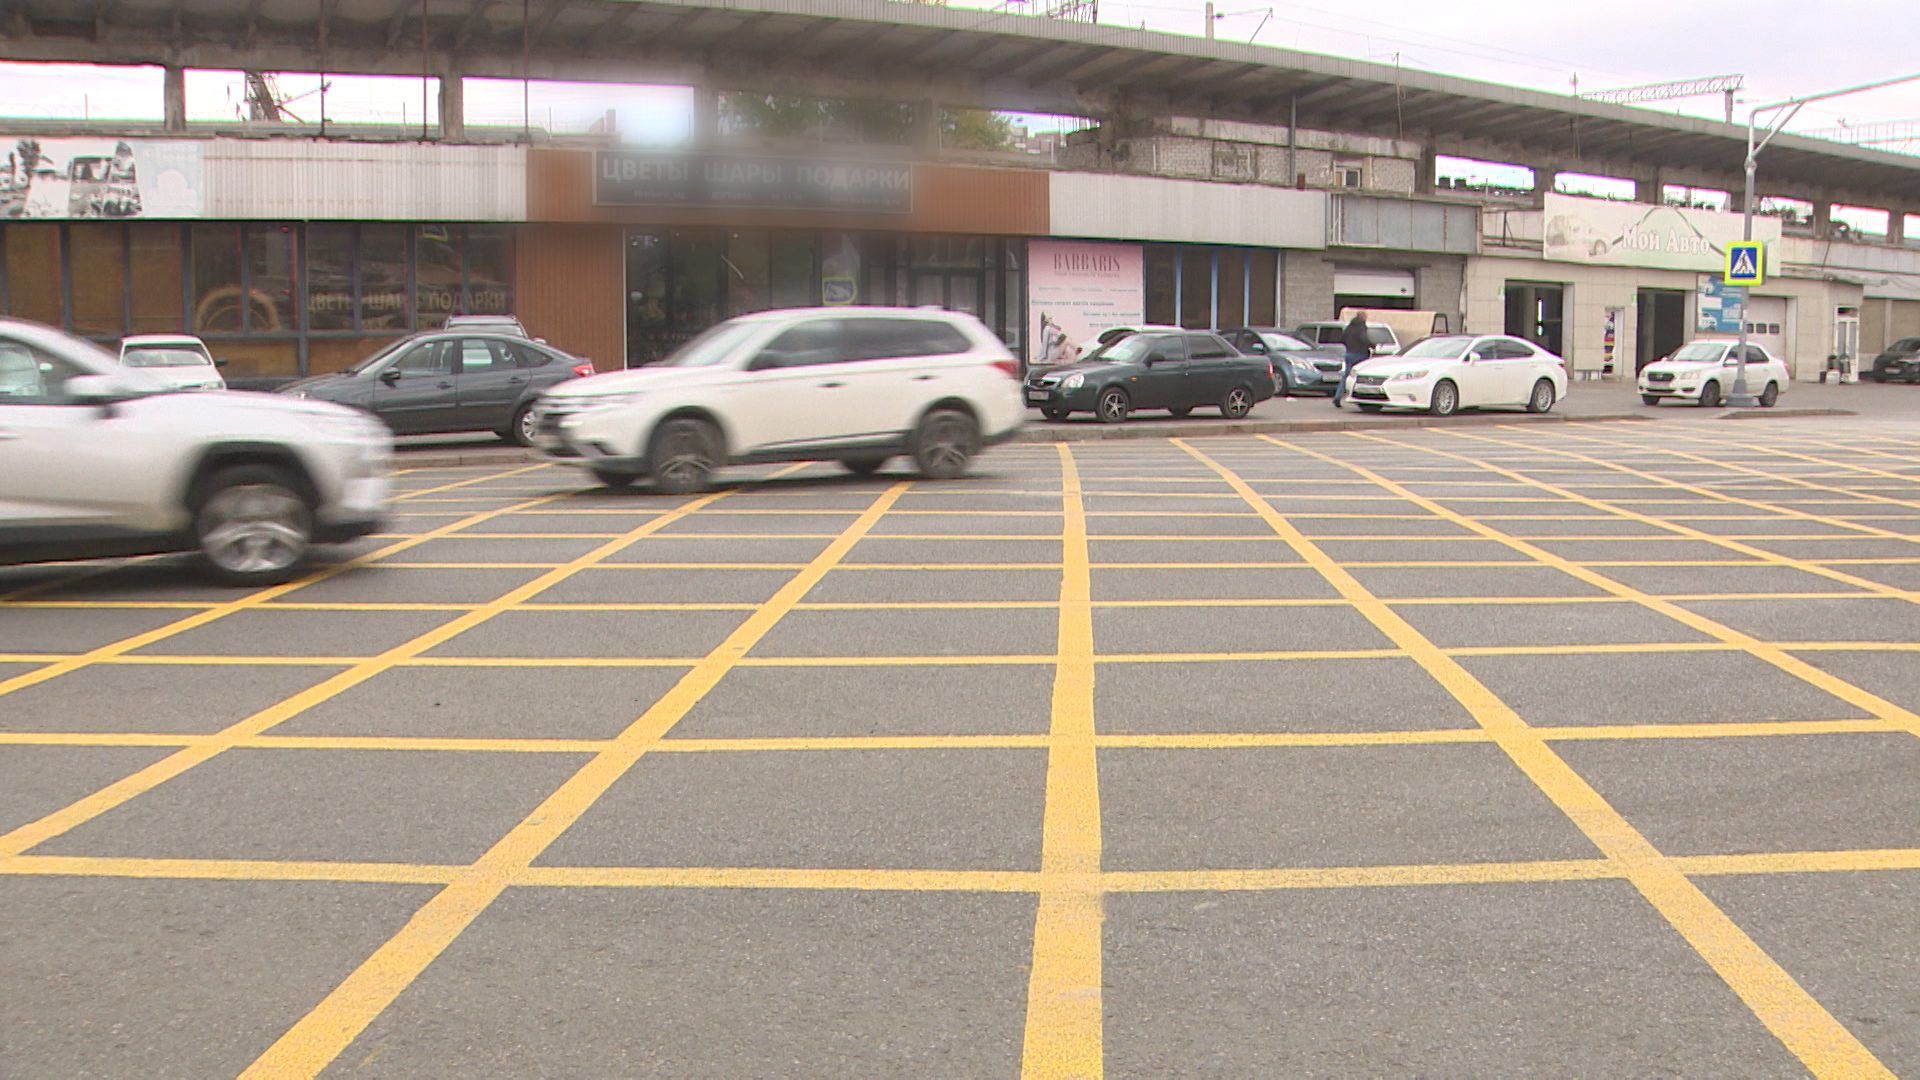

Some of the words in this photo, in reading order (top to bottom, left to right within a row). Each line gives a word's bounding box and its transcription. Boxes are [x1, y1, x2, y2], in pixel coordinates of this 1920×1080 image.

[602, 158, 689, 184] ЦВЕТЫ
[704, 161, 783, 184] ШАРЫ
[796, 166, 910, 191] ПОДАРКИ
[1622, 223, 1661, 250] Мой
[1665, 227, 1710, 255] Авто
[1053, 253, 1121, 272] BARBARIS
